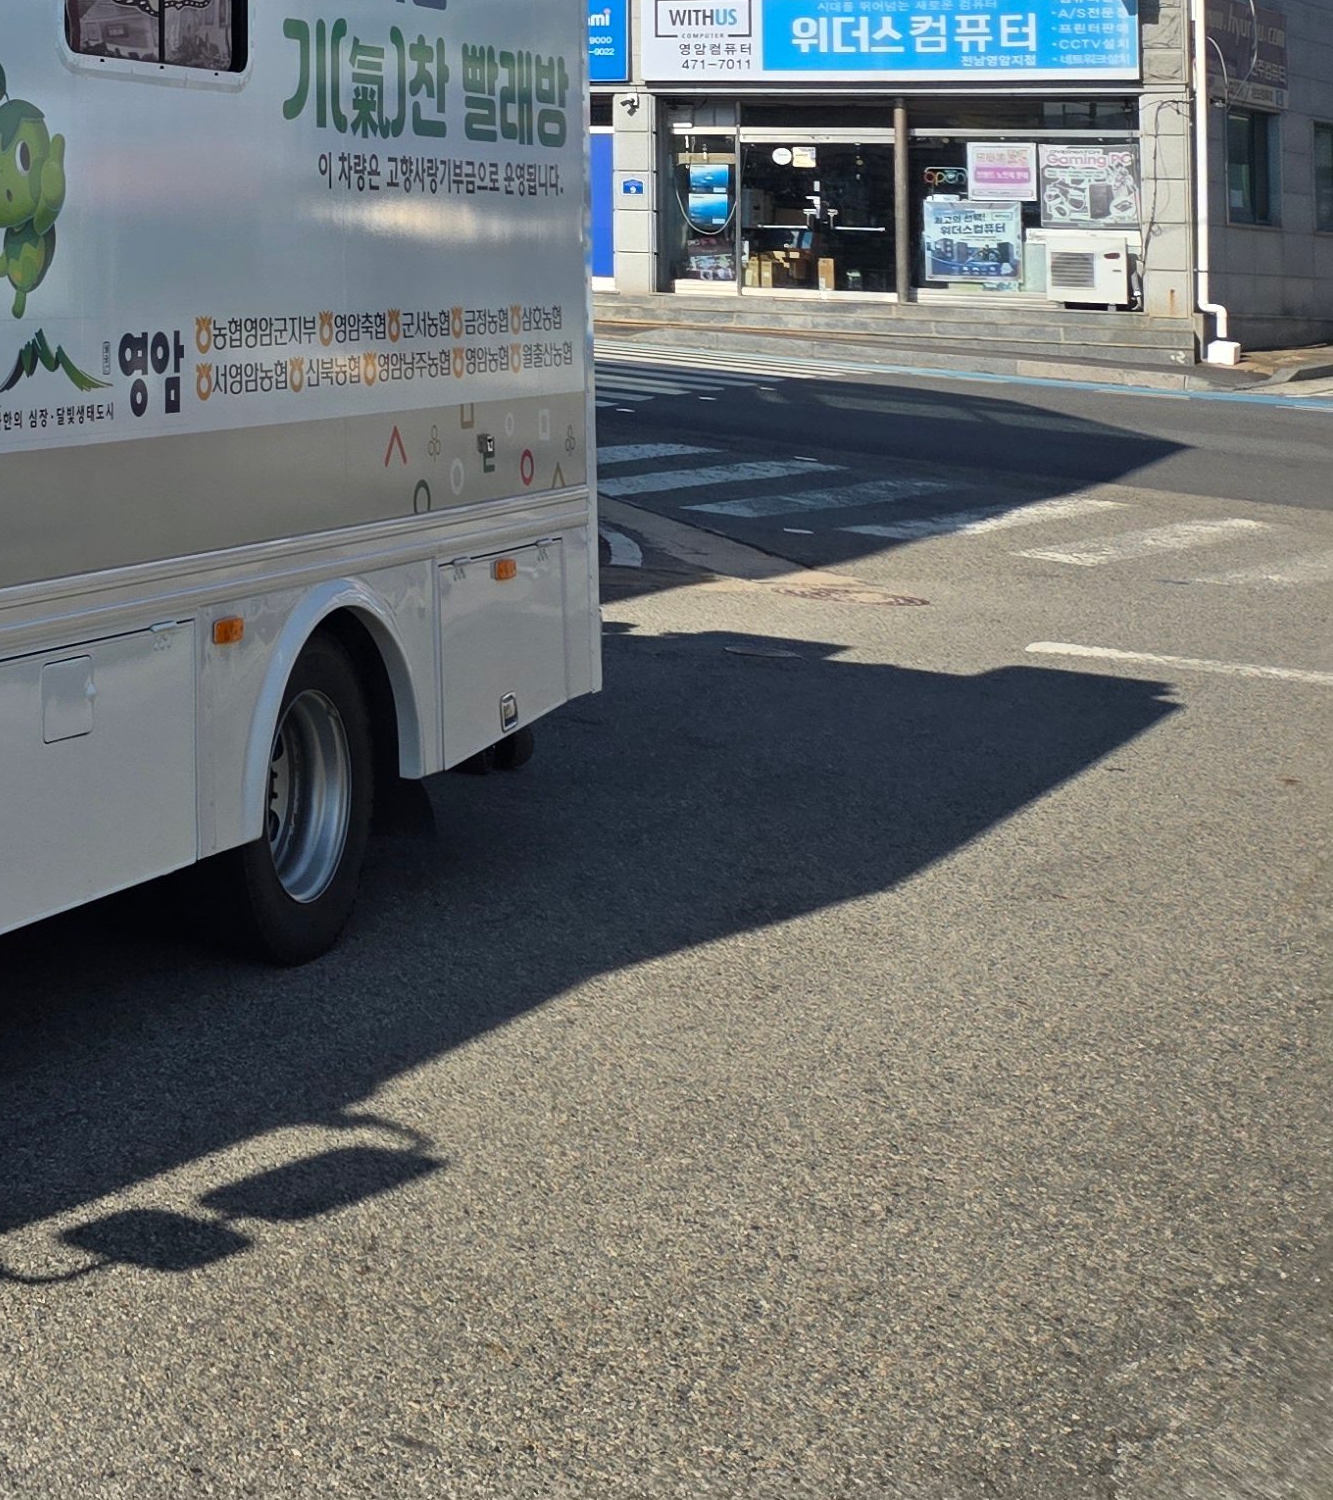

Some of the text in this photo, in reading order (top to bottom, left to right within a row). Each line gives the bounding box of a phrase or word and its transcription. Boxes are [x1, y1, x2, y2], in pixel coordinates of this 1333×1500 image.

[588, 8, 610, 26] mi
[669, 8, 737, 27] WITHUS
[791, 12, 1037, 53] 위더스컴퓨터
[679, 43, 752, 55] 영암컴퓨터
[681, 58, 752, 70] 471-7011
[462, 42, 569, 148] 빨래방
[318, 152, 564, 196] 이 차량은 고향사랑기부금으로 운영됩니다.
[1046, 152, 1133, 168] Gaming PC
[940, 222, 1006, 235] 위더스컴퓨터
[334, 312, 387, 343] 영암축협
[401, 310, 451, 338] 군서농협
[465, 307, 509, 335] 금정농협
[521, 305, 562, 331] 삼호농협
[212, 315, 316, 350] 농협영암군지부
[465, 345, 509, 375] 영암농협
[522, 341, 573, 369] 월출산농협
[119, 330, 185, 417] 영암
[212, 357, 288, 395] 서영암농협
[306, 355, 361, 387] 신북농협
